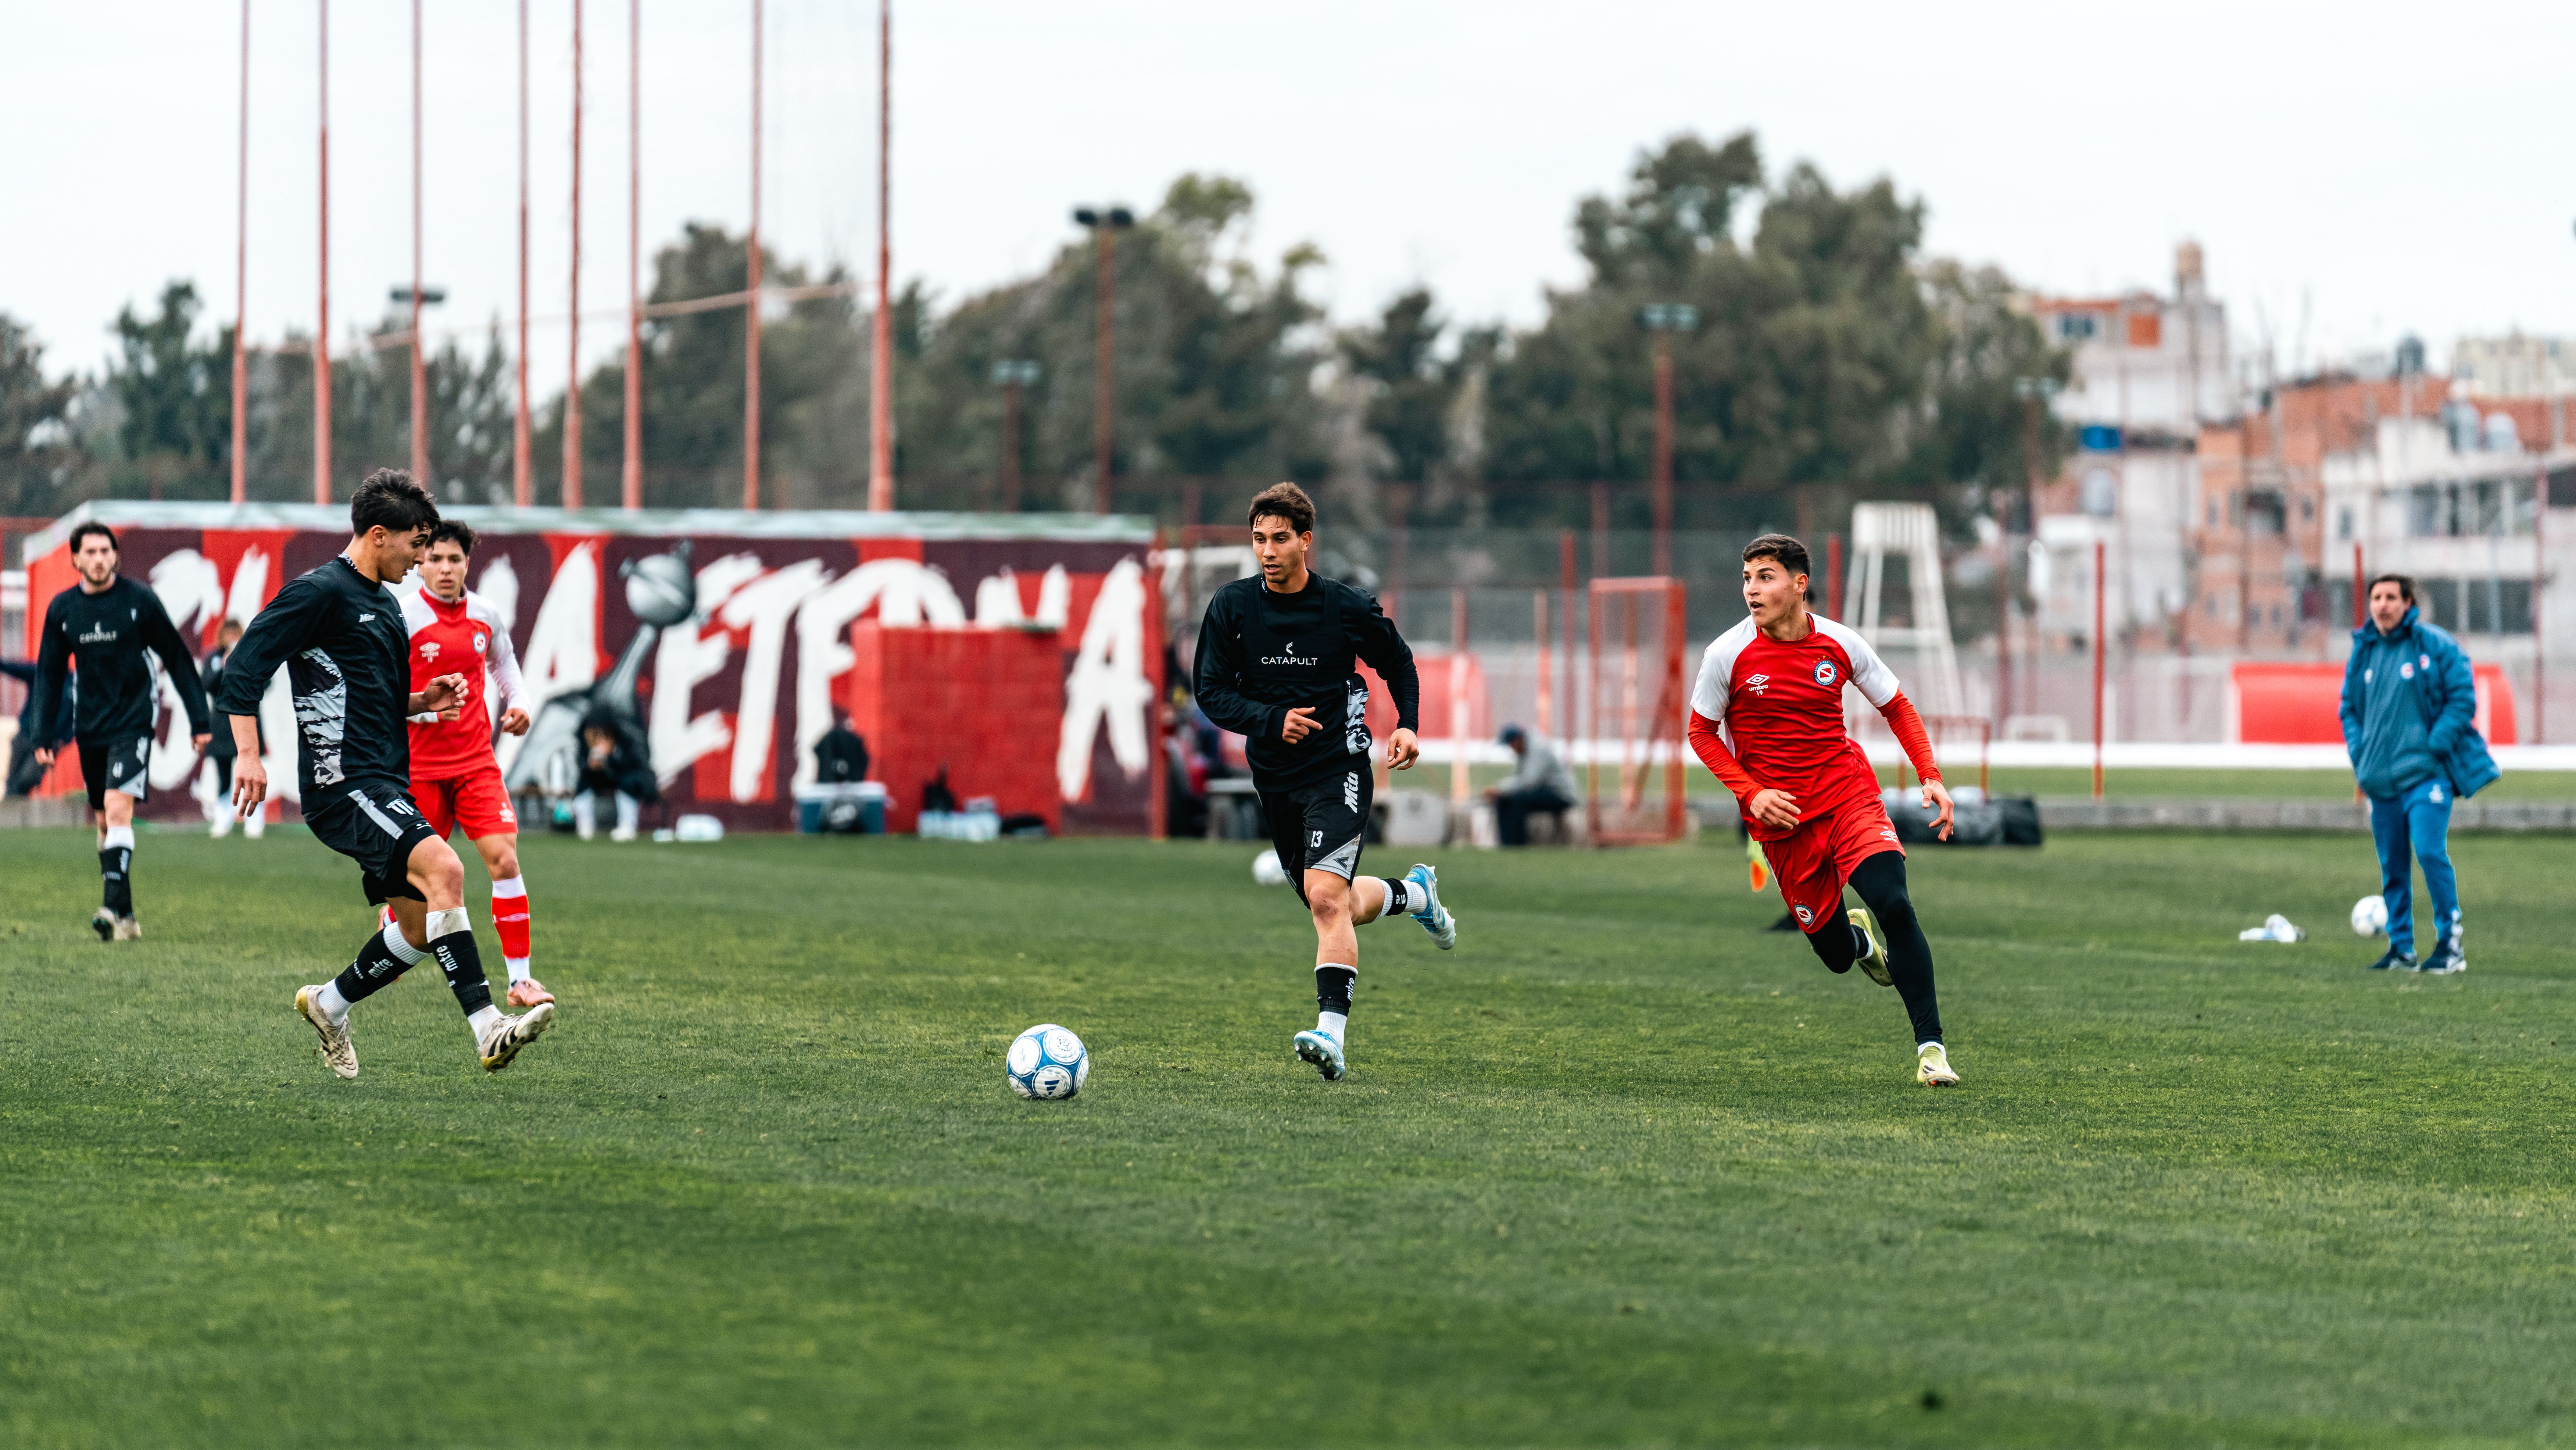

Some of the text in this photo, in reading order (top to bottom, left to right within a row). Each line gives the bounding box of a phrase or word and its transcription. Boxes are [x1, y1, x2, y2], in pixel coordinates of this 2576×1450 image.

[1261, 657, 1318, 665] CATAPULT
[1344, 771, 1359, 814] Mitr
[1311, 830, 1323, 847] 13
[368, 959, 394, 978] mitre
[436, 945, 458, 971] mitre
[1345, 978, 1355, 1001] mitre
